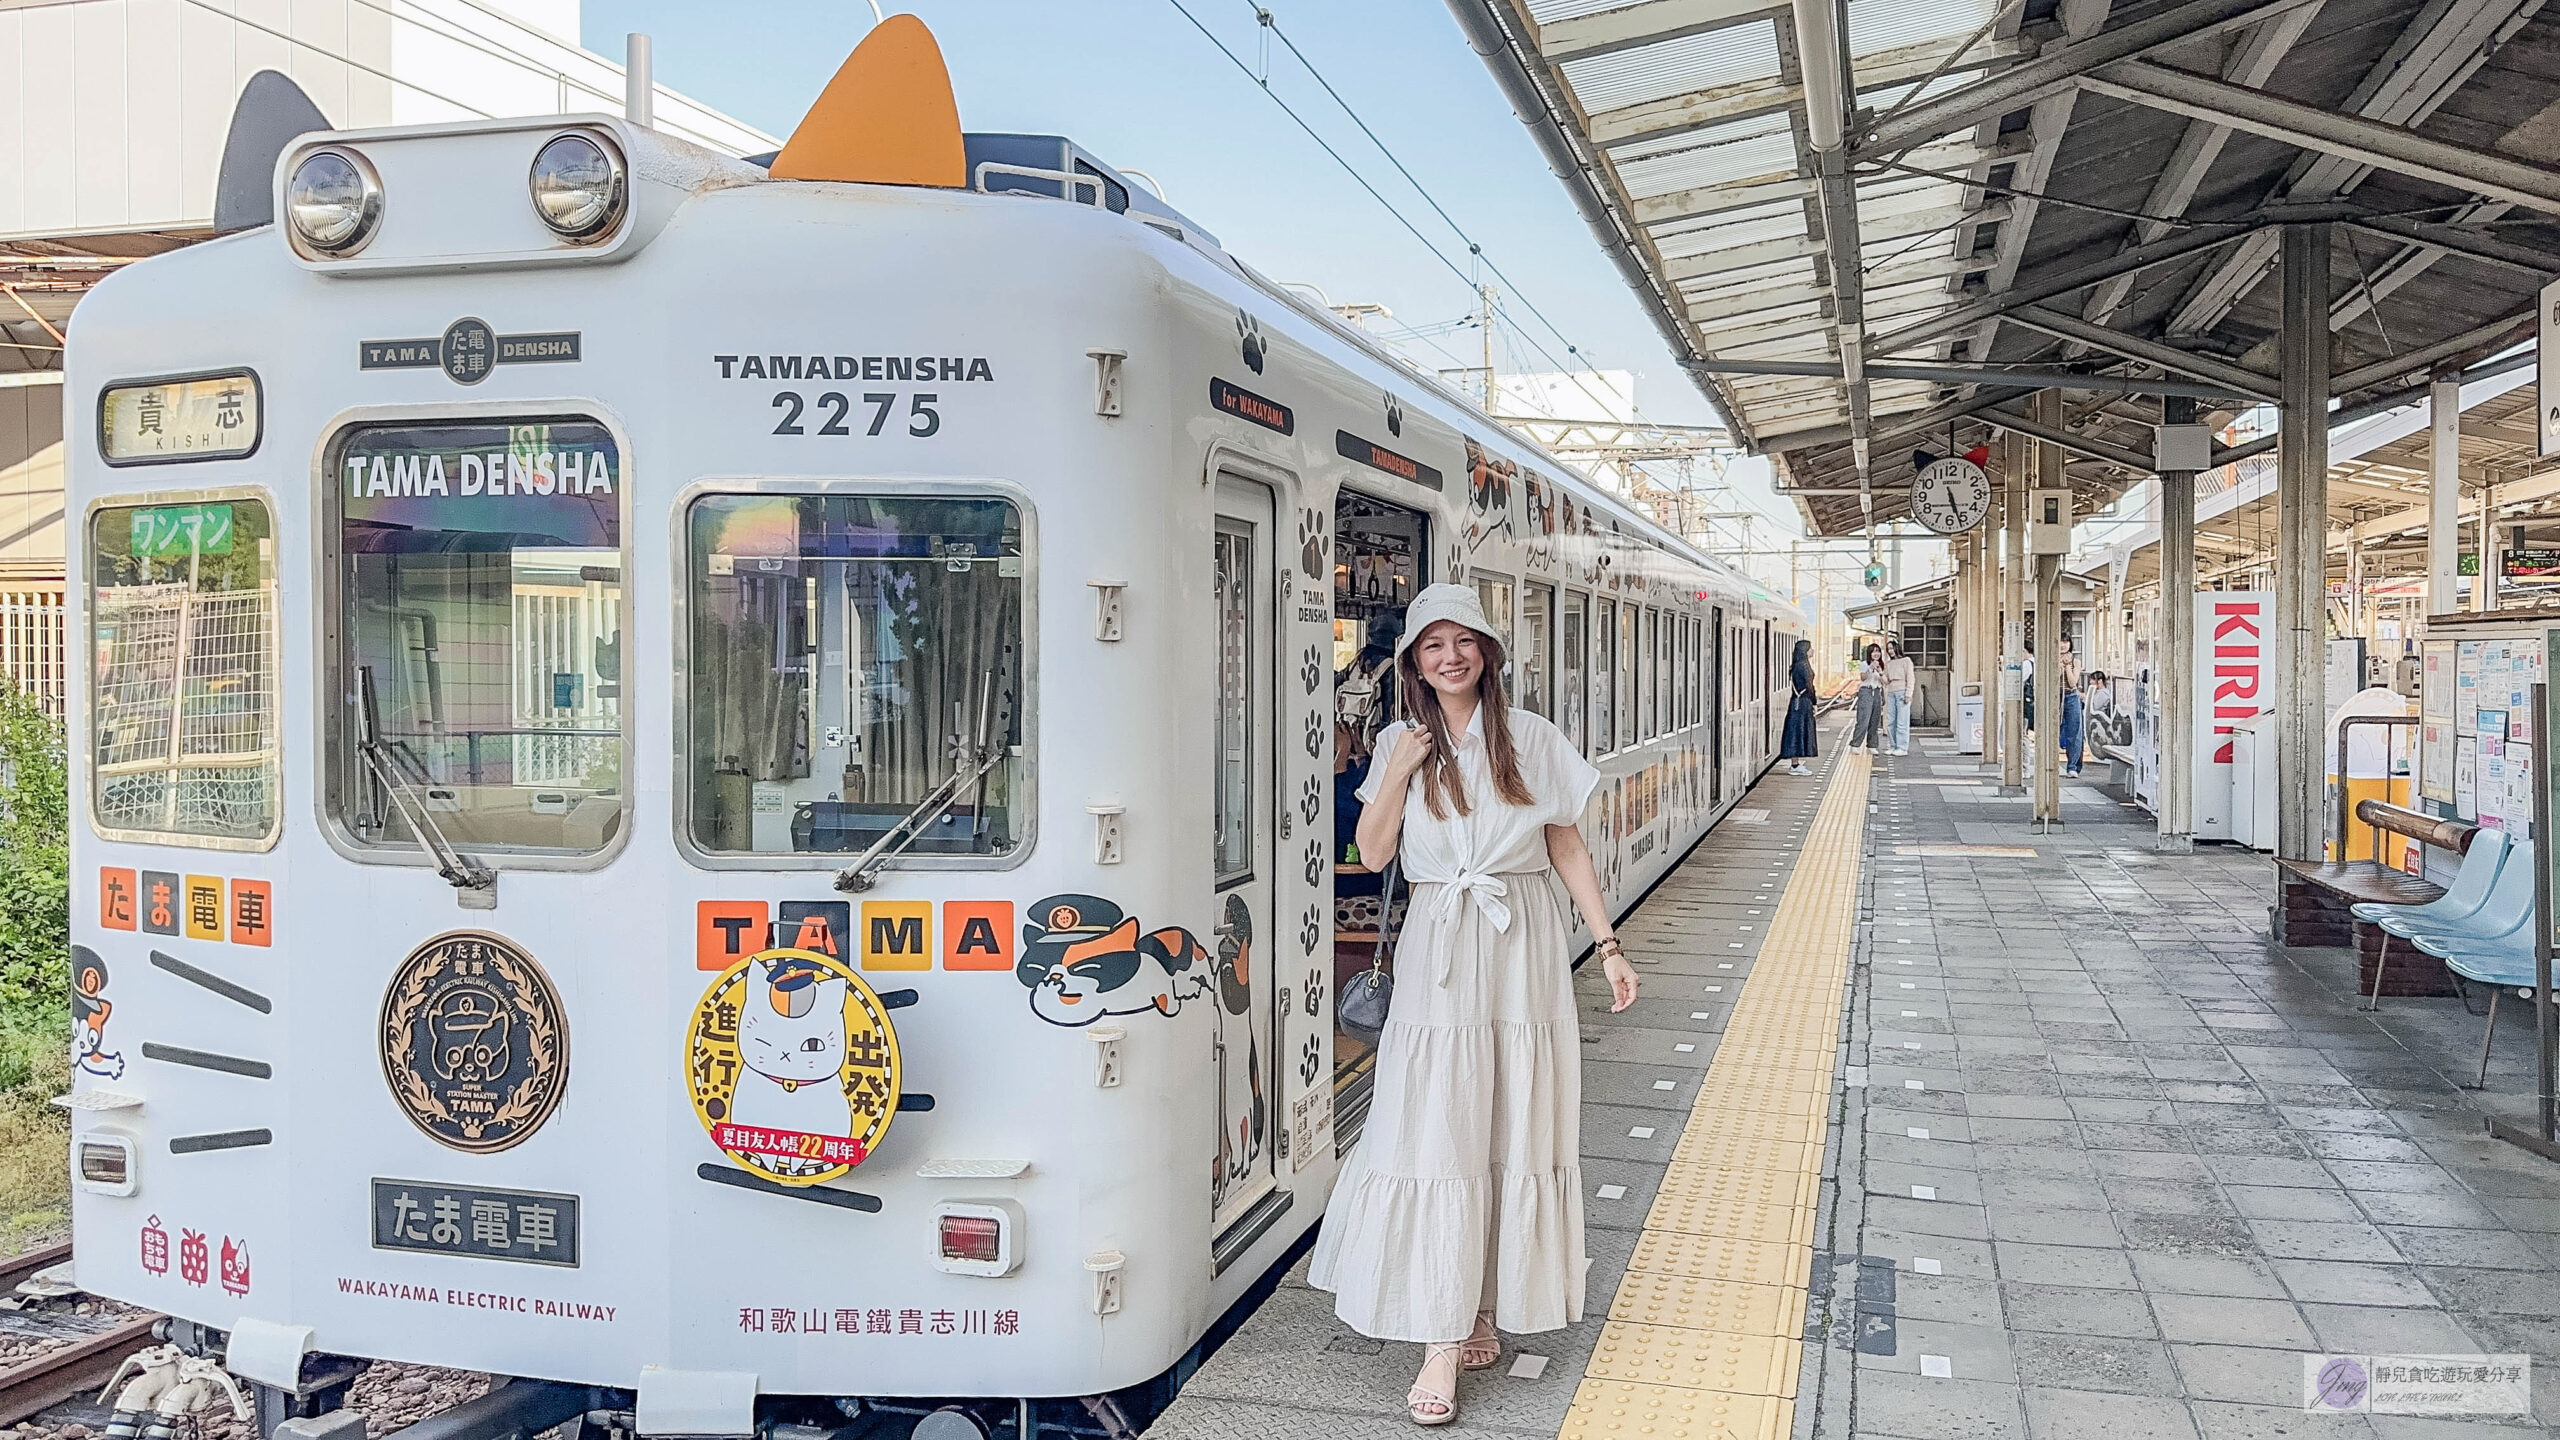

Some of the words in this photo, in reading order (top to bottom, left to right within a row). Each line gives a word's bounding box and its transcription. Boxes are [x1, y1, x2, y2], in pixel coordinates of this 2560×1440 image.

[370, 347, 430, 362] TAMA
[503, 341, 572, 357] DENSHA
[714, 355, 994, 382] TAMADENSHA
[771, 391, 940, 438] 2275
[1222, 387, 1236, 409] for
[1239, 395, 1284, 428] WAKAYAMA
[156, 433, 226, 451] KISHI
[1371, 448, 1417, 479] TAMADENSHA
[1945, 465, 1958, 477] 12
[348, 455, 449, 497] TAMA
[460, 451, 613, 496] DENSHA
[1933, 468, 1943, 480] 11
[1963, 468, 1967, 479] 1
[1970, 476, 1979, 487] 2
[1922, 479, 1934, 490] 10
[1918, 491, 1927, 502] 9
[1973, 489, 1982, 500] 3
[1923, 503, 1932, 514] 8
[1969, 502, 1978, 512] 4
[1933, 513, 1942, 523] 7
[1945, 515, 1954, 526] 6
[1960, 512, 1968, 522] 5
[132, 509, 232, 552] ワンマン
[1303, 590, 1325, 606] TAMA
[1298, 607, 1328, 623] DENSHA
[108, 876, 265, 936] たま電車
[713, 917, 1000, 955] TAMA
[456, 943, 483, 959] たま
[454, 960, 485, 976] 電車
[700, 1001, 737, 1086] 進行
[845, 1030, 886, 1117] 出発
[446, 1090, 472, 1099] STATION
[473, 1092, 499, 1100] MASTER
[462, 1083, 482, 1091] SUPER
[450, 1099, 495, 1114] TAMA
[393, 1191, 558, 1252] たま電車
[338, 1277, 439, 1304] WAKAYAMA
[447, 1291, 527, 1314] ELECTRIC
[535, 1300, 617, 1323] RAILWAY
[739, 1307, 1020, 1336] 和歌山電鐵貴志川線
